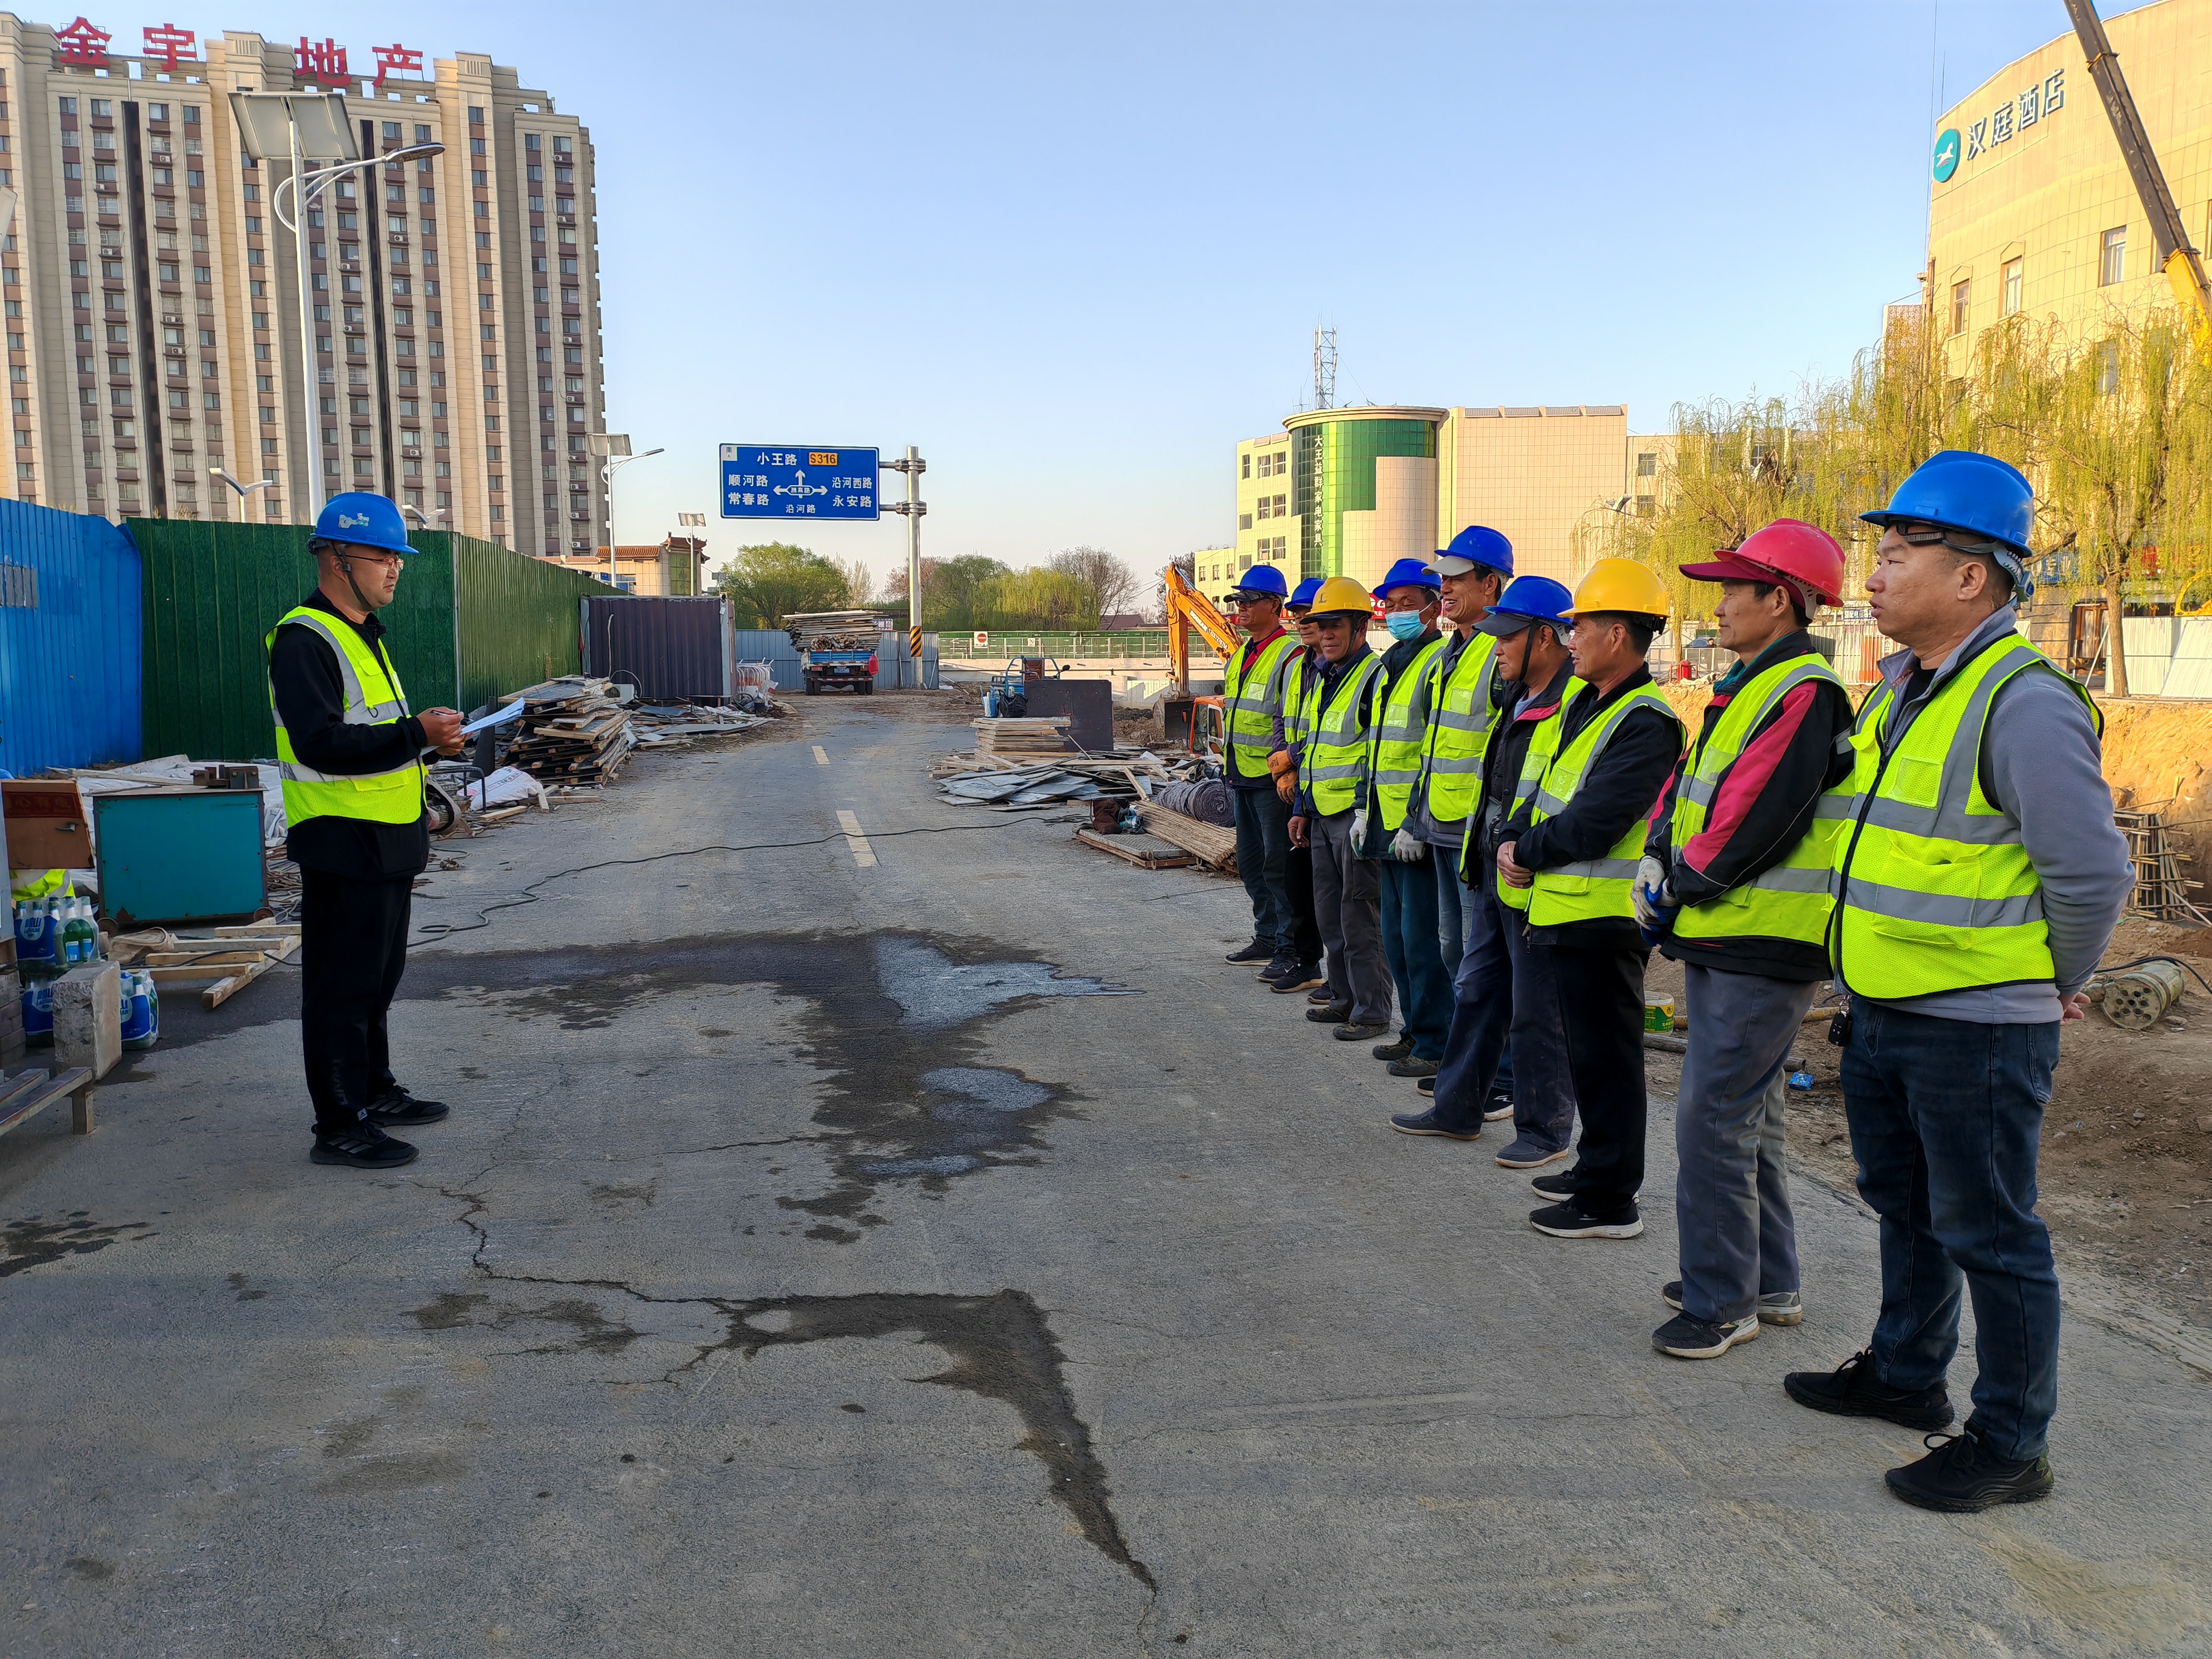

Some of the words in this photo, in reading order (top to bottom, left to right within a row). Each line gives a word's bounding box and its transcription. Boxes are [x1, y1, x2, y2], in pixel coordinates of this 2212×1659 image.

[55, 16, 423, 87] 金宇地产
[1966, 68, 2065, 161] 汉庭酒店
[757, 451, 797, 466] 小王路
[810, 454, 836, 464] S316
[728, 474, 768, 487] 顺河路
[832, 477, 873, 489] 沿河西路
[1314, 435, 1324, 547] 大王益群家电家具
[728, 492, 769, 505] 常春路
[832, 495, 872, 508] 永安路
[786, 504, 815, 514] 沿河路
